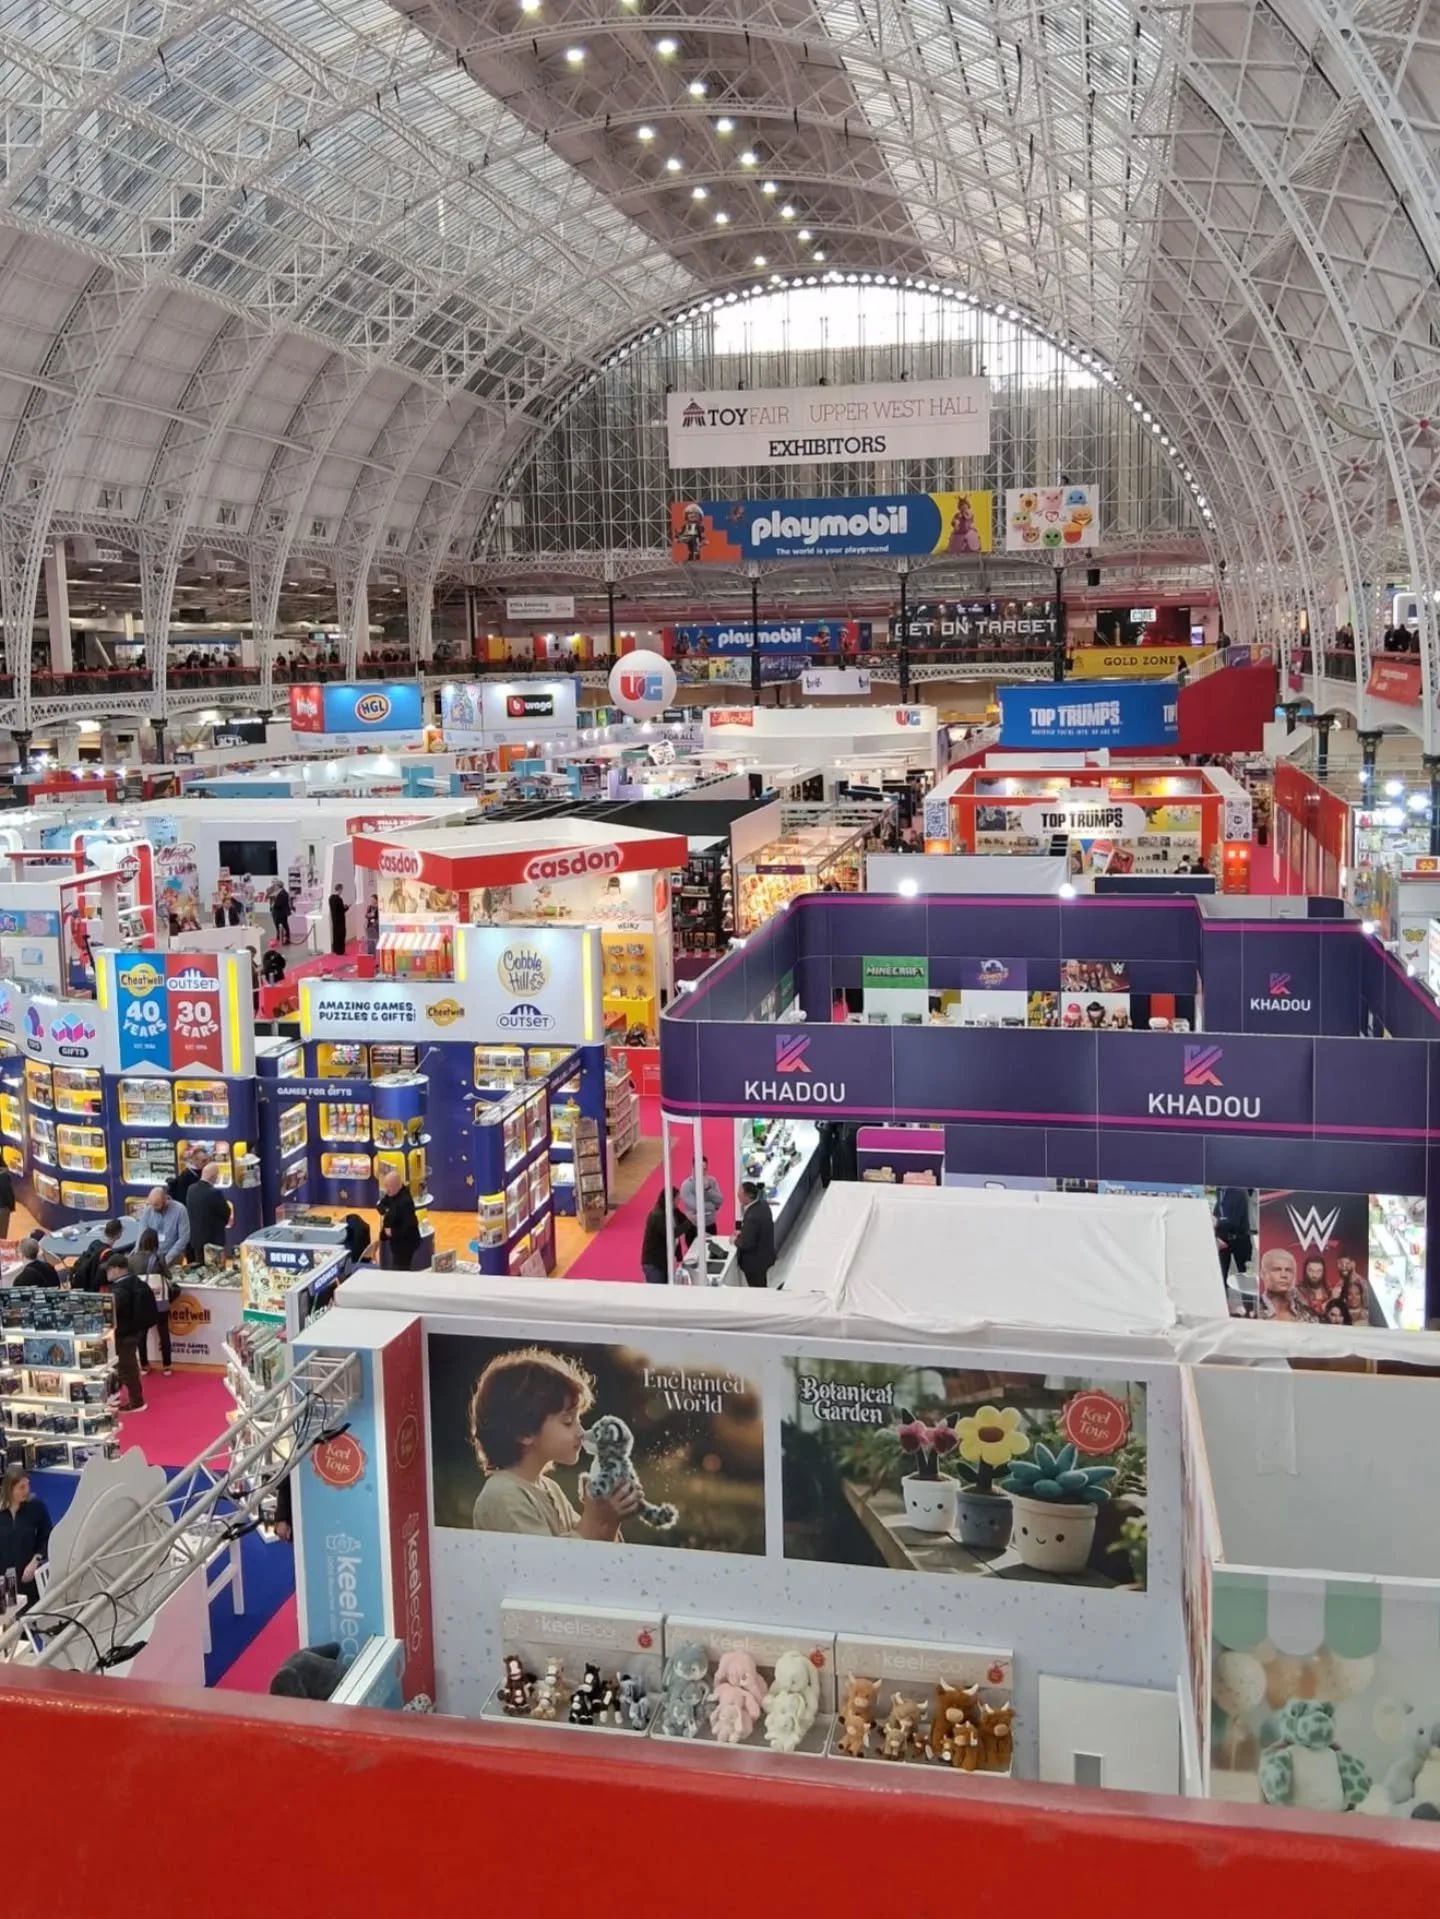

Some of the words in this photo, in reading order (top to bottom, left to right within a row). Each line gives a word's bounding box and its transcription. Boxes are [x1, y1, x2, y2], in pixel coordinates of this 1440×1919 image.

[810, 402, 868, 423] UPPER
[873, 399, 924, 419] WEST
[929, 397, 978, 416] HALL
[769, 436, 886, 457] EXHIBITORS
[751, 506, 907, 546] playmobil
[776, 547, 790, 556] The
[792, 547, 814, 556] world
[815, 546, 823, 555] is
[824, 547, 843, 557] your
[844, 544, 889, 555] playground
[942, 619, 968, 635] ON
[975, 619, 1056, 634] TARGET
[718, 627, 801, 648] playmobil
[1104, 656, 1138, 666] GOLD
[1143, 655, 1177, 666] ZONE
[361, 701, 384, 715] HGL
[1030, 708, 1055, 727] TOP
[1057, 701, 1120, 727] TRUMPS
[1042, 813, 1066, 828] TOP
[1069, 808, 1123, 828] TRUMPS
[380, 852, 418, 873] casdon
[528, 849, 619, 880] casdon
[617, 922, 639, 930] HEINZ
[503, 950, 542, 972] Cobble
[121, 974, 163, 986] Cheatwell
[509, 971, 530, 993] Hill
[866, 967, 925, 977] MINECRAFT
[126, 1001, 160, 1022] 40
[177, 1001, 211, 1023] 30
[319, 1001, 371, 1010] AMAZING
[1250, 998, 1311, 1012] KHADOU
[319, 1012, 368, 1021] PUZZLES
[371, 1012, 379, 1021] &
[381, 1012, 416, 1022] GIFTS!
[123, 1019, 167, 1038] YEARS
[174, 1020, 219, 1038] YEARS
[61, 1048, 85, 1057] GIFTS
[277, 1087, 307, 1096] GAMES
[309, 1088, 326, 1096] FOR
[328, 1088, 353, 1096] GIFTS
[744, 1081, 846, 1103] KHADOU
[1149, 1093, 1261, 1118] KHADOU
[270, 1252, 296, 1263] DEVIR
[643, 1368, 745, 1395] Enchanted
[800, 1375, 894, 1405] Botanical
[663, 1391, 723, 1414] World
[813, 1401, 883, 1424] Garden
[1081, 1406, 1112, 1425] Keel
[1080, 1421, 1110, 1440] Toys
[326, 1444, 351, 1459] Keel
[325, 1455, 351, 1474] Toys
[408, 1529, 422, 1652] keeleco
[541, 1615, 615, 1638] keeleco
[882, 1651, 962, 1673] keeleco
